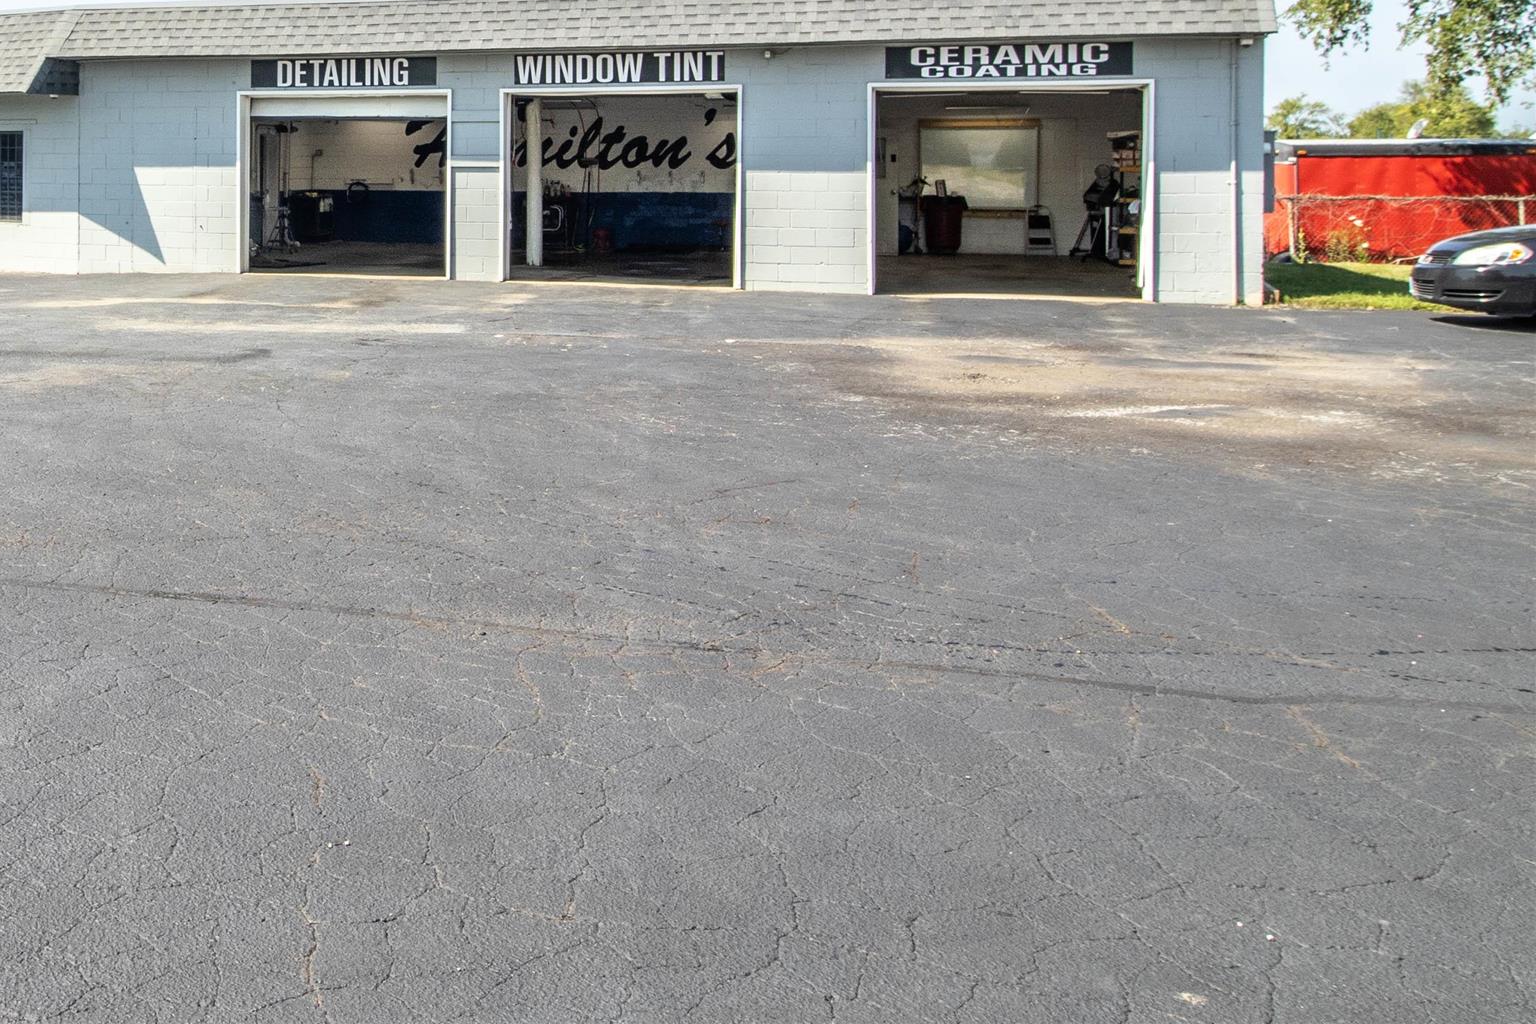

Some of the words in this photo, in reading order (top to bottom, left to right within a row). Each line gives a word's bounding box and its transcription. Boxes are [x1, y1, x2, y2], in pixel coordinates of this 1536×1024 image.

[516, 53, 644, 85] WINDOW
[653, 51, 724, 83] TINT
[910, 43, 1110, 66] CERAMIC
[276, 57, 409, 88] DETAILING
[920, 63, 1098, 78] COATING
